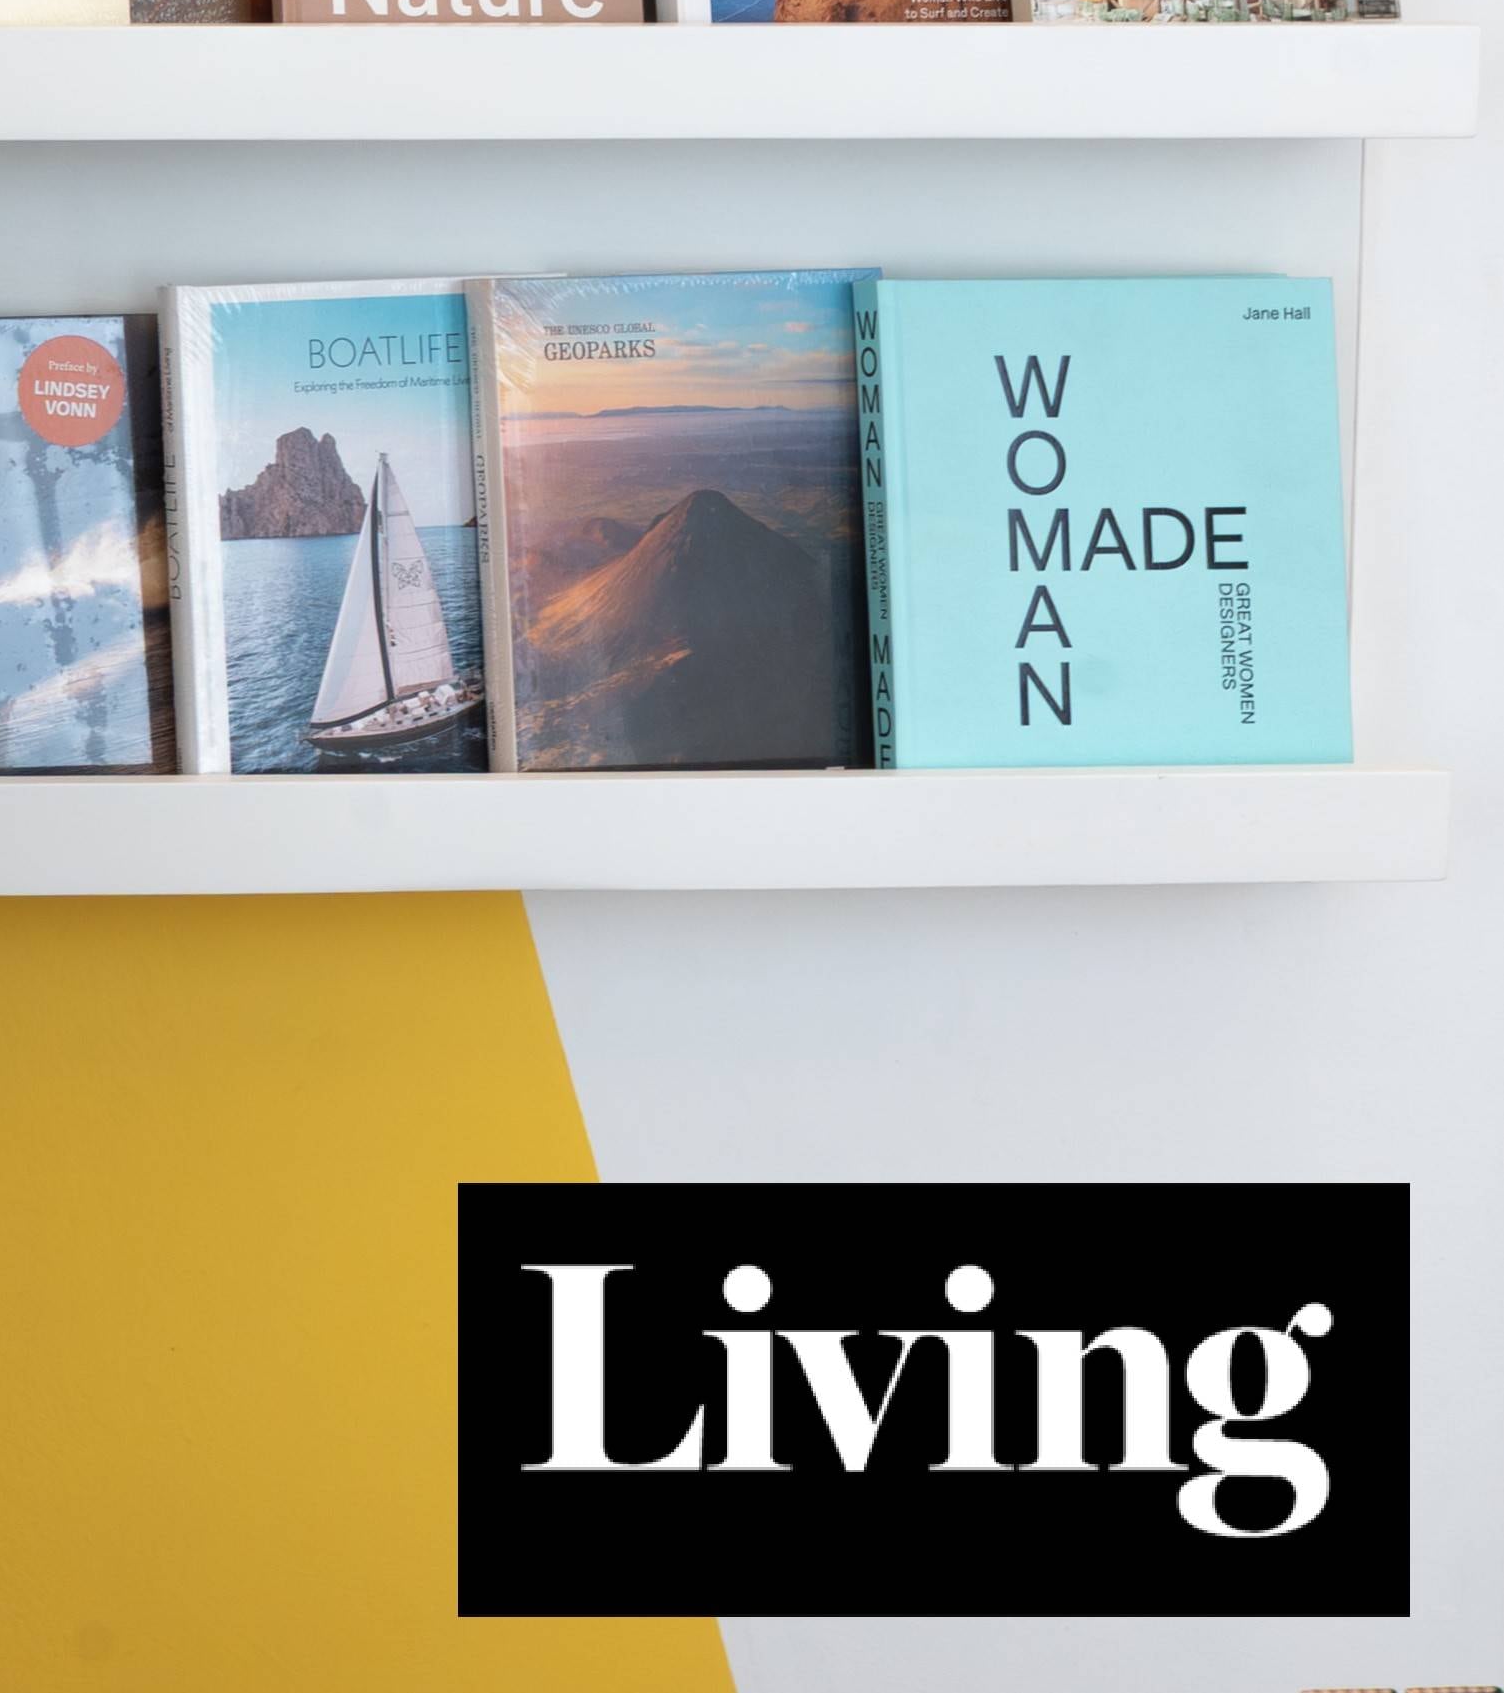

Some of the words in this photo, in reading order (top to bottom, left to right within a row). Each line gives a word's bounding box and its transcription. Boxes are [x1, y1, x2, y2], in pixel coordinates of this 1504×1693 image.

[904, 8, 918, 20] to
[919, 7, 945, 19] Surf
[947, 7, 968, 18] and
[969, 6, 1009, 18] Create
[1242, 305, 1279, 321] Jane
[1282, 305, 1311, 321] Hall
[308, 332, 464, 369] BOATLIFE
[543, 338, 656, 361] GEOPARKS
[48, 360, 85, 373] Preface
[34, 379, 111, 400] LINDSEY
[294, 381, 338, 395] Exploring
[339, 379, 354, 391] the
[355, 377, 397, 390] Freedom
[399, 376, 409, 388] of
[45, 399, 97, 419] VONN
[994, 354, 1074, 727] WOMAN
[1006, 505, 1249, 572] MADE
[1234, 581, 1253, 643] GREAT
[1218, 581, 1237, 690] DESIGNERS
[1236, 648, 1256, 726] WOMEN
